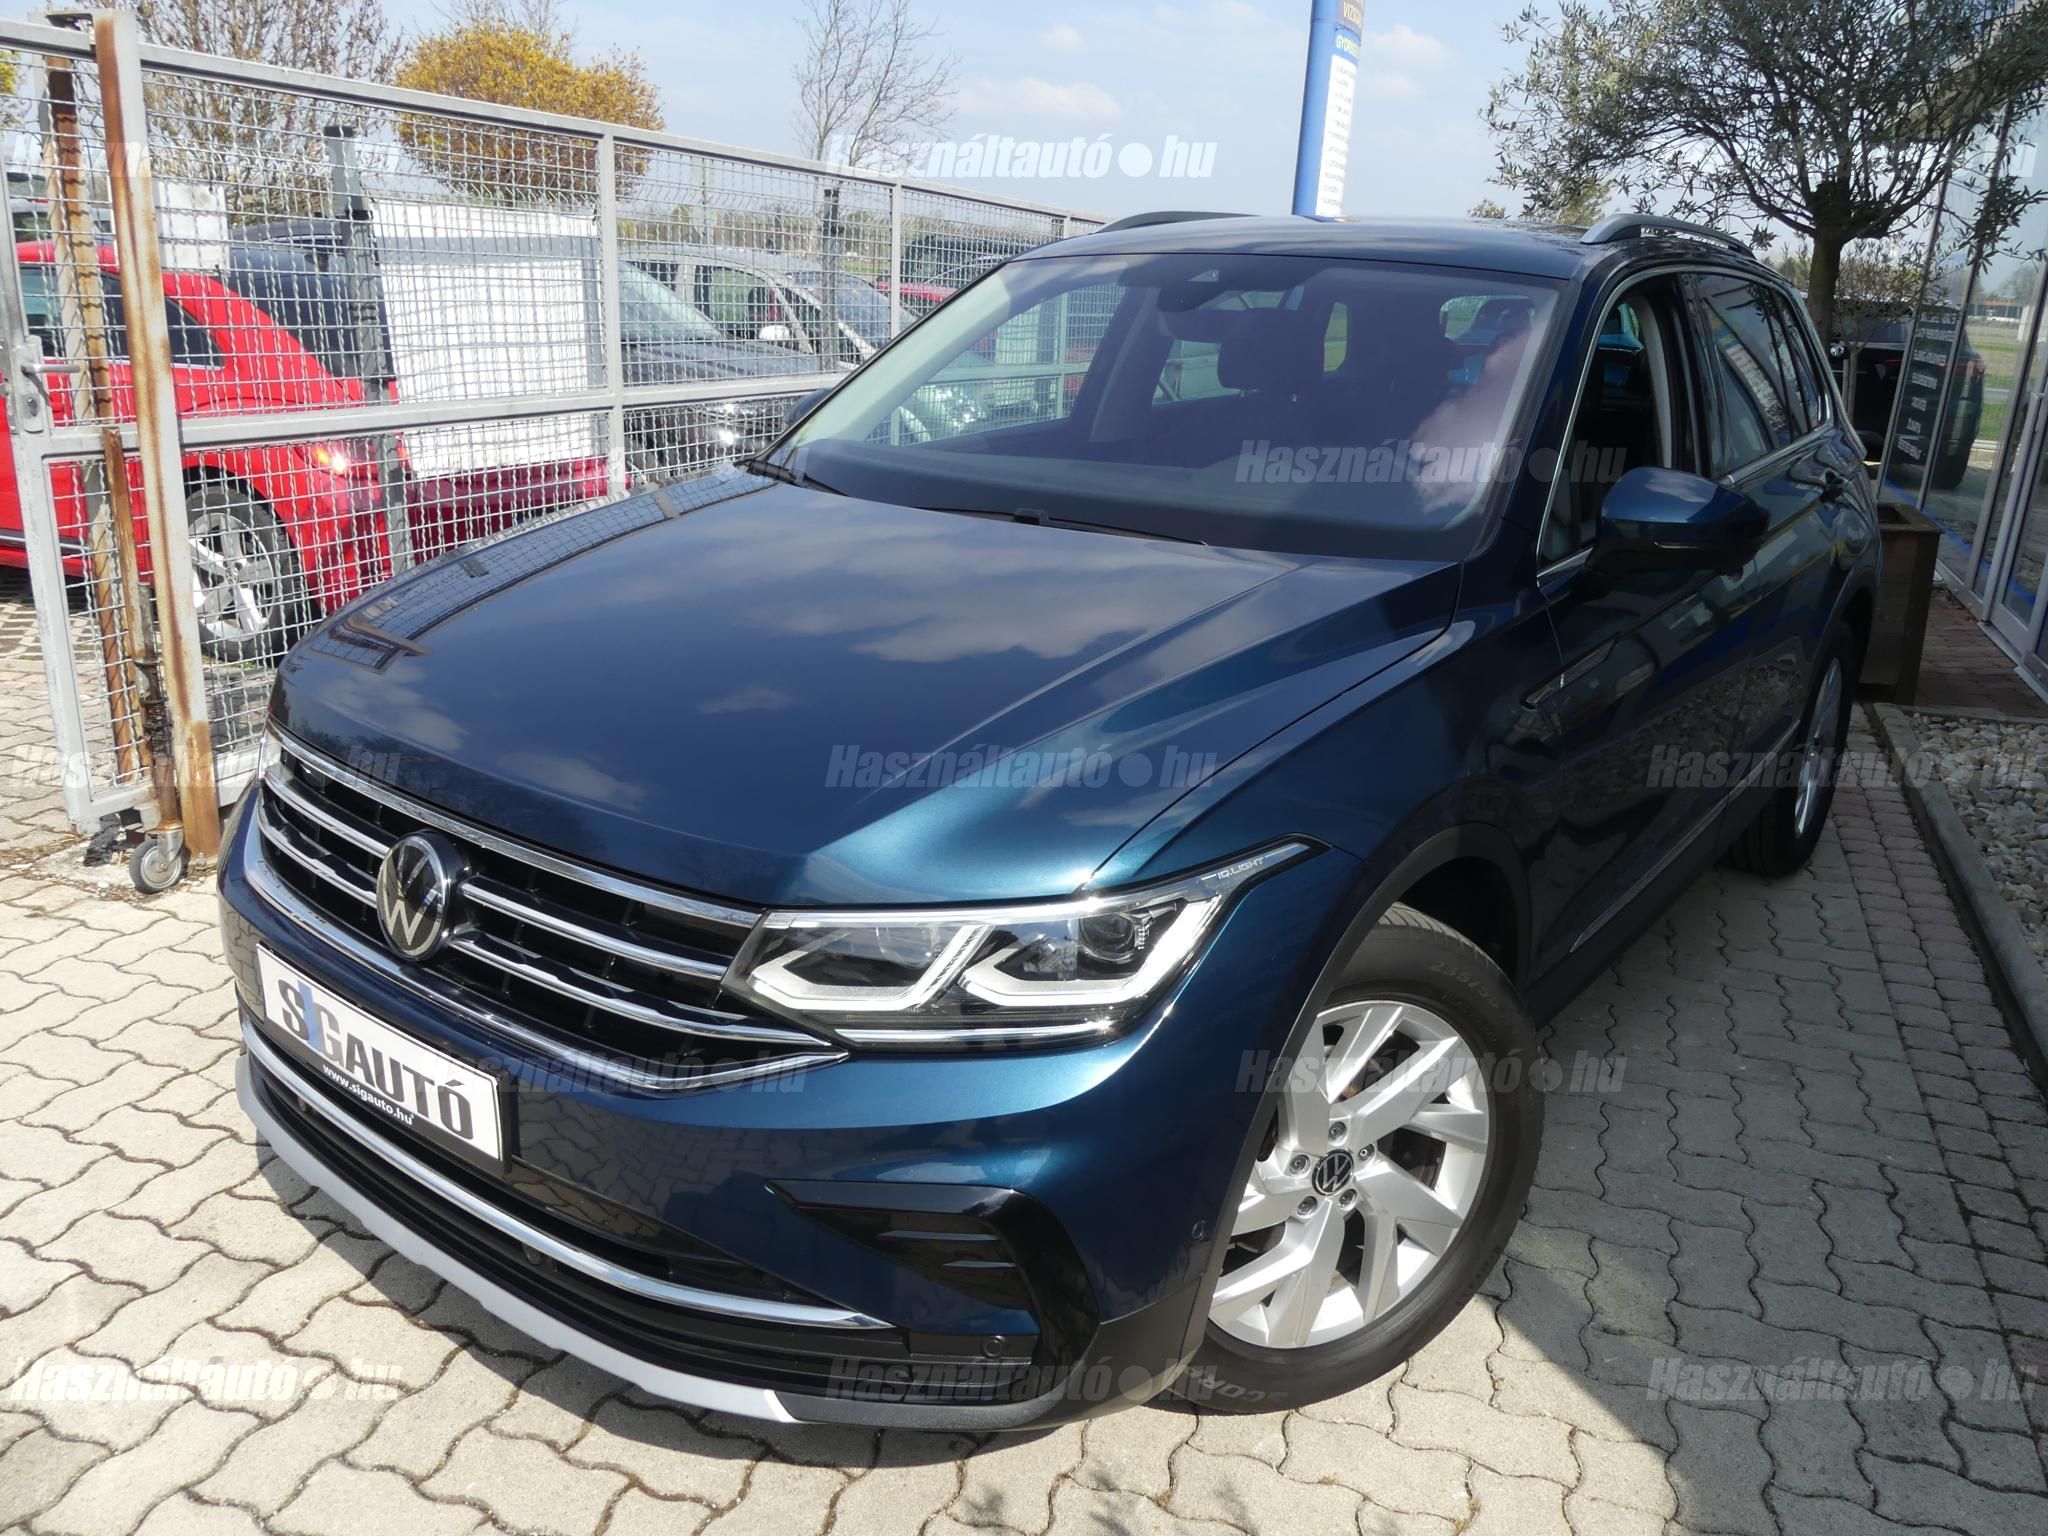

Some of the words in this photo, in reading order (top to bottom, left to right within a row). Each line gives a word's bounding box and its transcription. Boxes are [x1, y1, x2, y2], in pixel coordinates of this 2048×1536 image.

[1217, 857, 1264, 880] IQ.LIGHT
[278, 979, 474, 1140] SIGAUTÓ
[322, 1064, 413, 1125] www.sigauto.hu
